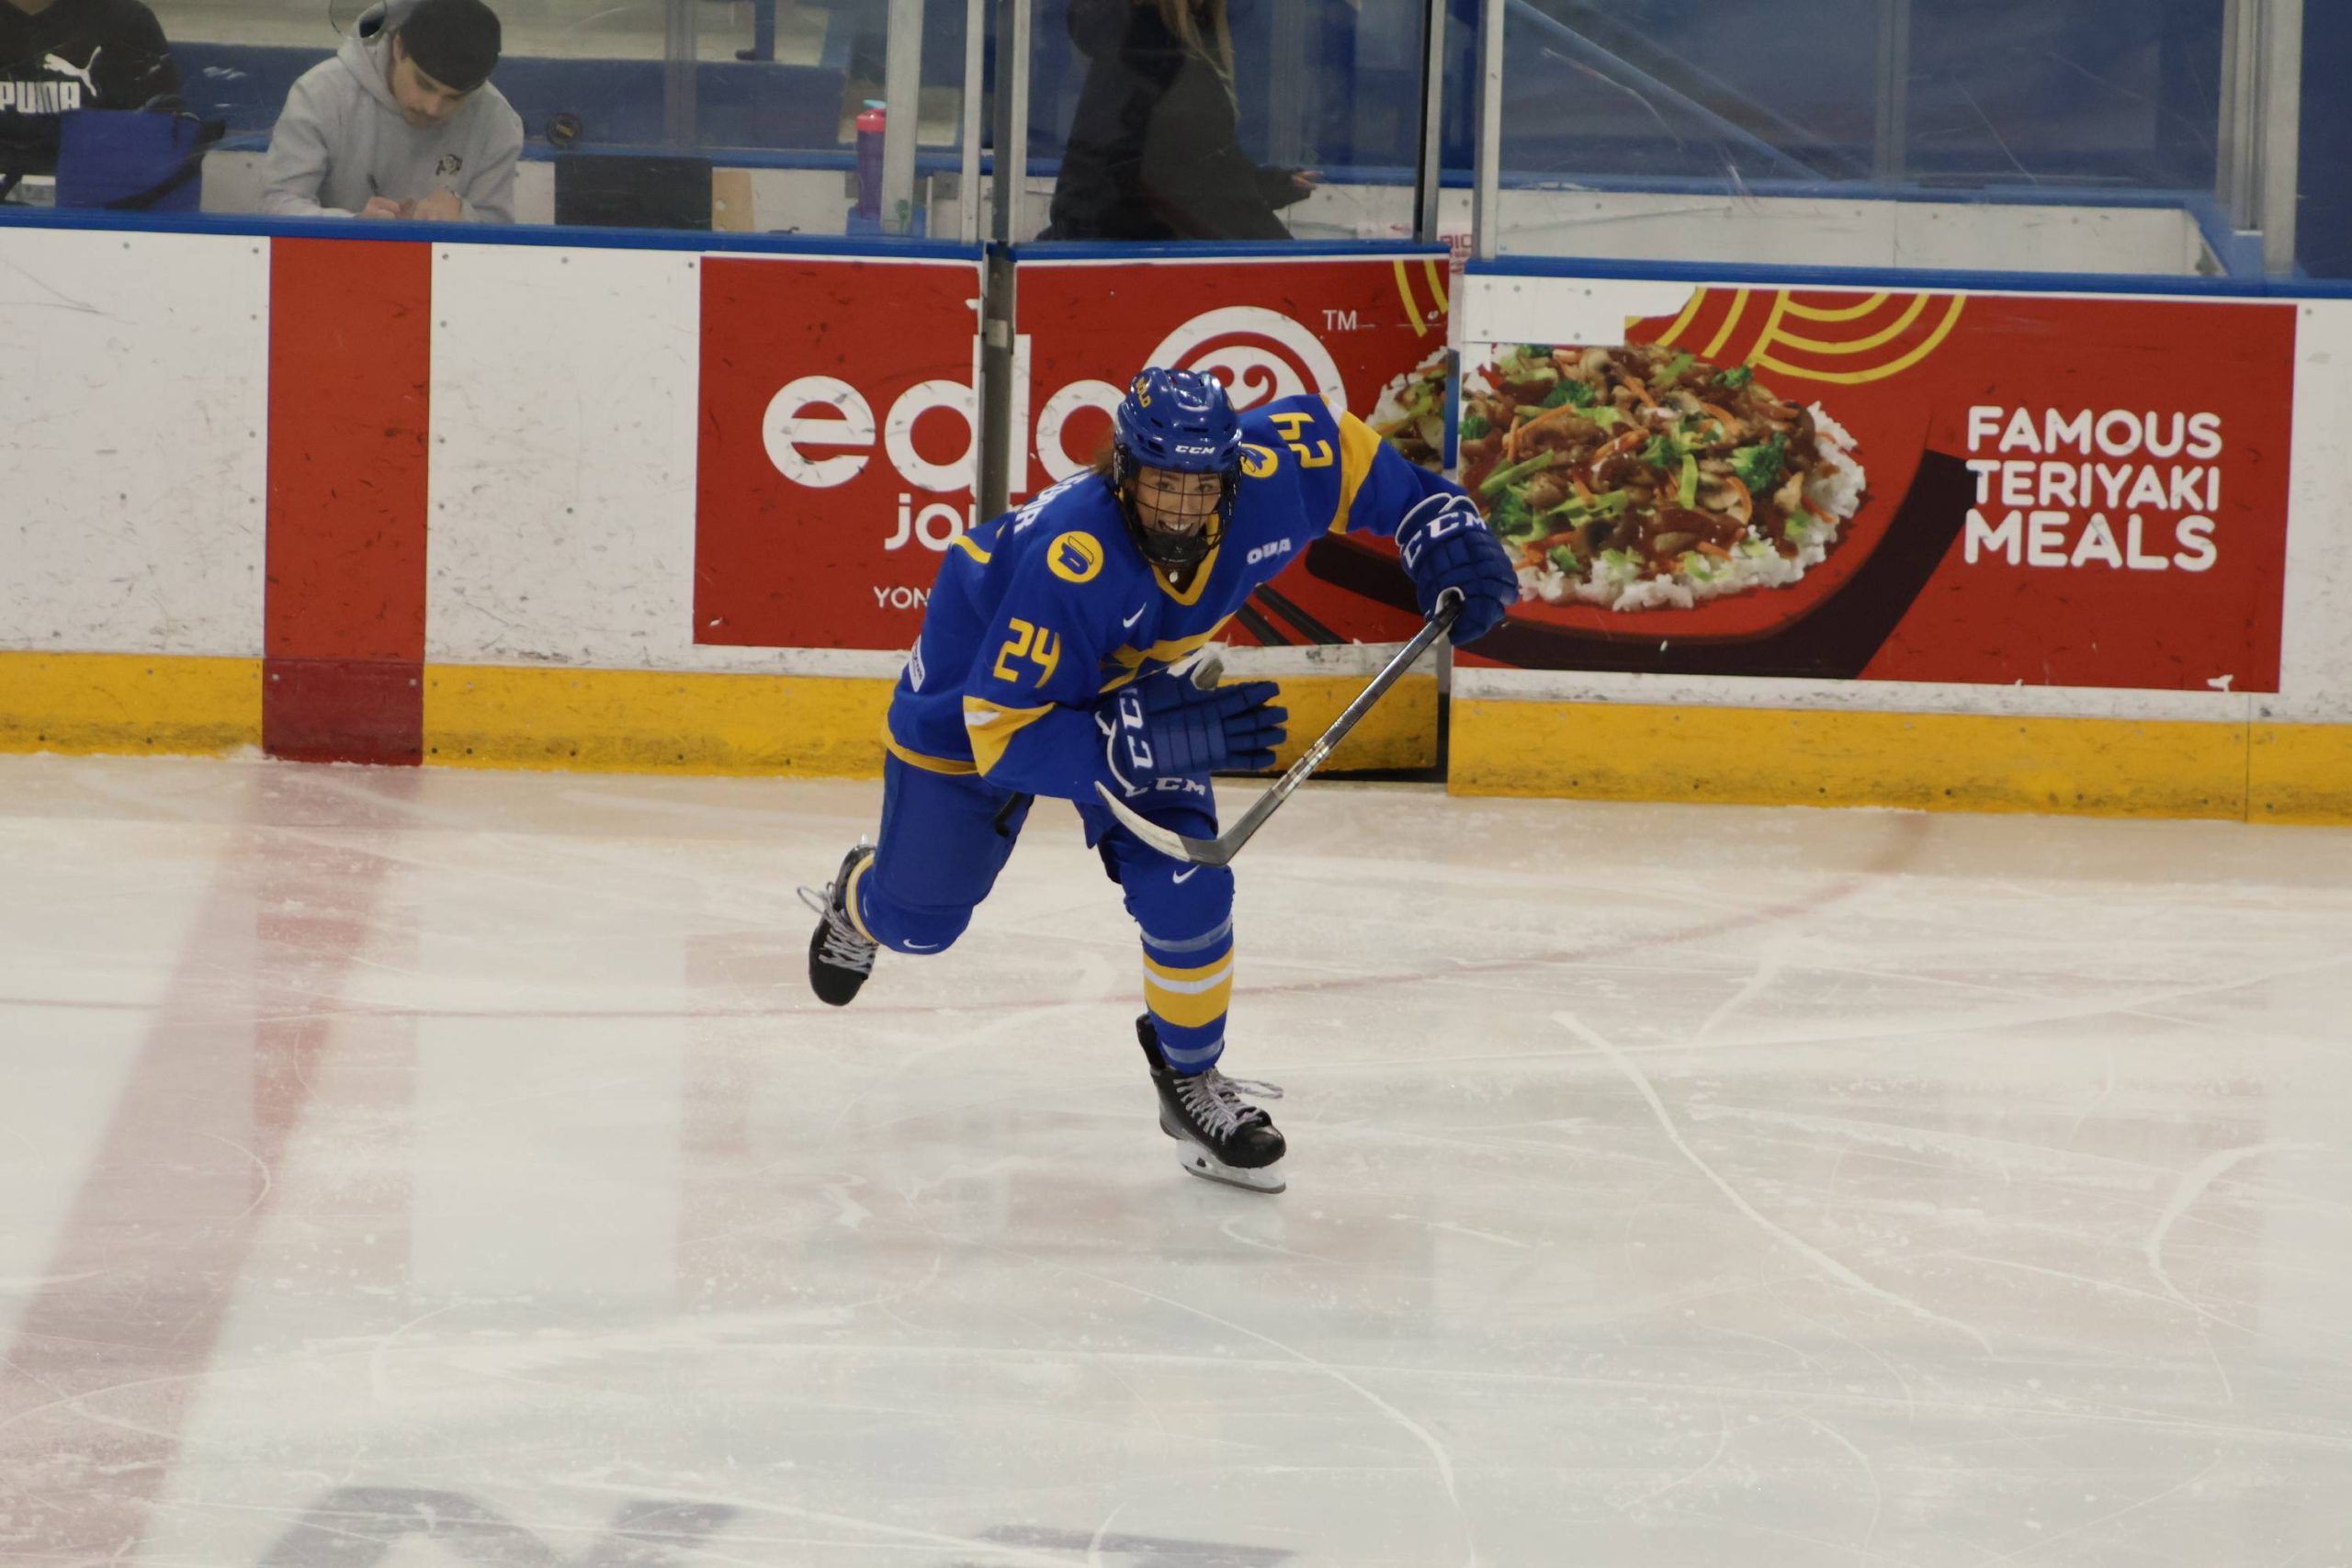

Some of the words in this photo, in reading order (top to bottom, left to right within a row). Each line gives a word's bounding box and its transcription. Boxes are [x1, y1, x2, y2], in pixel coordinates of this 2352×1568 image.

[0, 81, 81, 114] PUMA
[1323, 310, 1358, 332] TM
[1175, 445, 1216, 455] CCM
[1268, 412, 1334, 469] 24
[1967, 405, 2223, 459] FAMOUS
[1965, 459, 2221, 512] TERIYAKI
[884, 492, 977, 551] jo
[1403, 511, 1487, 569] CCM
[1964, 508, 2218, 572] MEALS
[1246, 537, 1292, 565] OUA
[993, 616, 1060, 689] 24
[1119, 687, 1154, 769] CC
